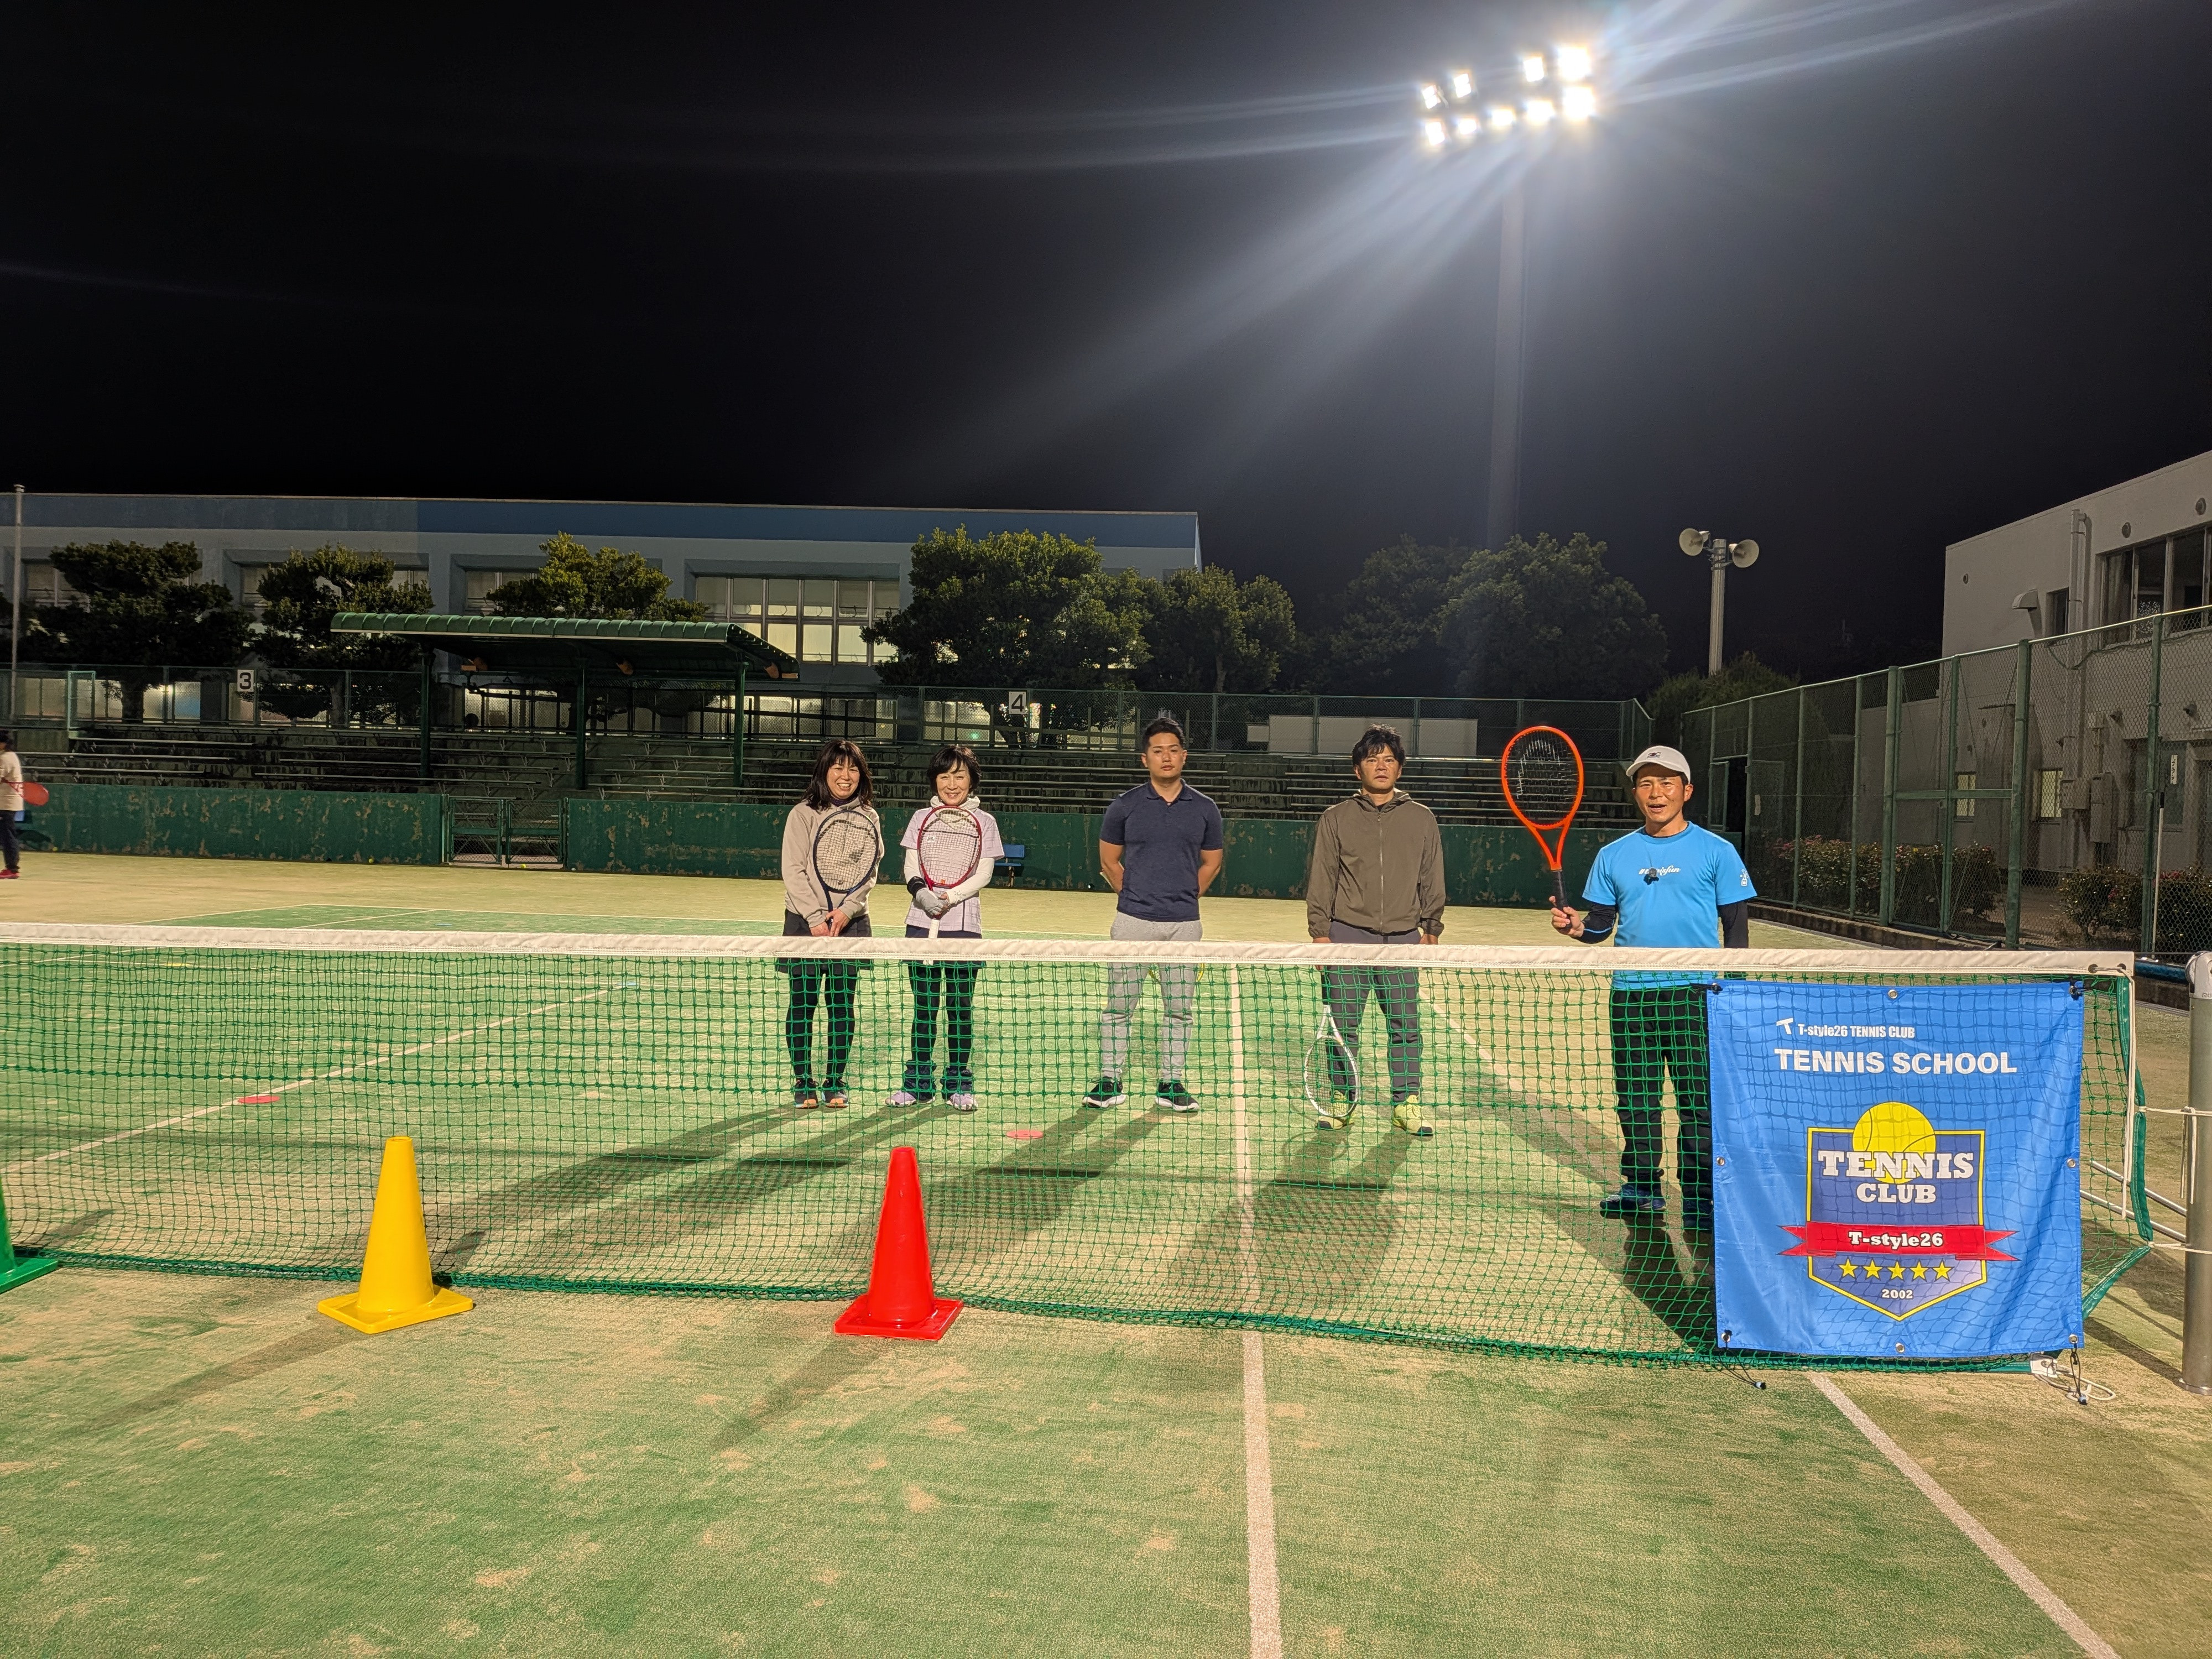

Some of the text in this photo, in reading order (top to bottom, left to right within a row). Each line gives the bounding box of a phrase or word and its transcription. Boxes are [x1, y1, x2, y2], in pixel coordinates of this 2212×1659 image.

[239, 672, 252, 690] 3
[1011, 694, 1024, 712] 4
[1639, 865, 1681, 876] #tnisfun
[1798, 1024, 1848, 1037] T-style26
[1850, 1026, 1886, 1038] TENNIS
[1888, 1027, 1915, 1039] CLUB
[1774, 1048, 2017, 1074] TENNIS SCHOOL
[1818, 1151, 1974, 1178] TENNIS
[1856, 1183, 1937, 1203] CLUB
[1849, 1232, 1943, 1249] T-style26
[1881, 1289, 1913, 1299] 2002
